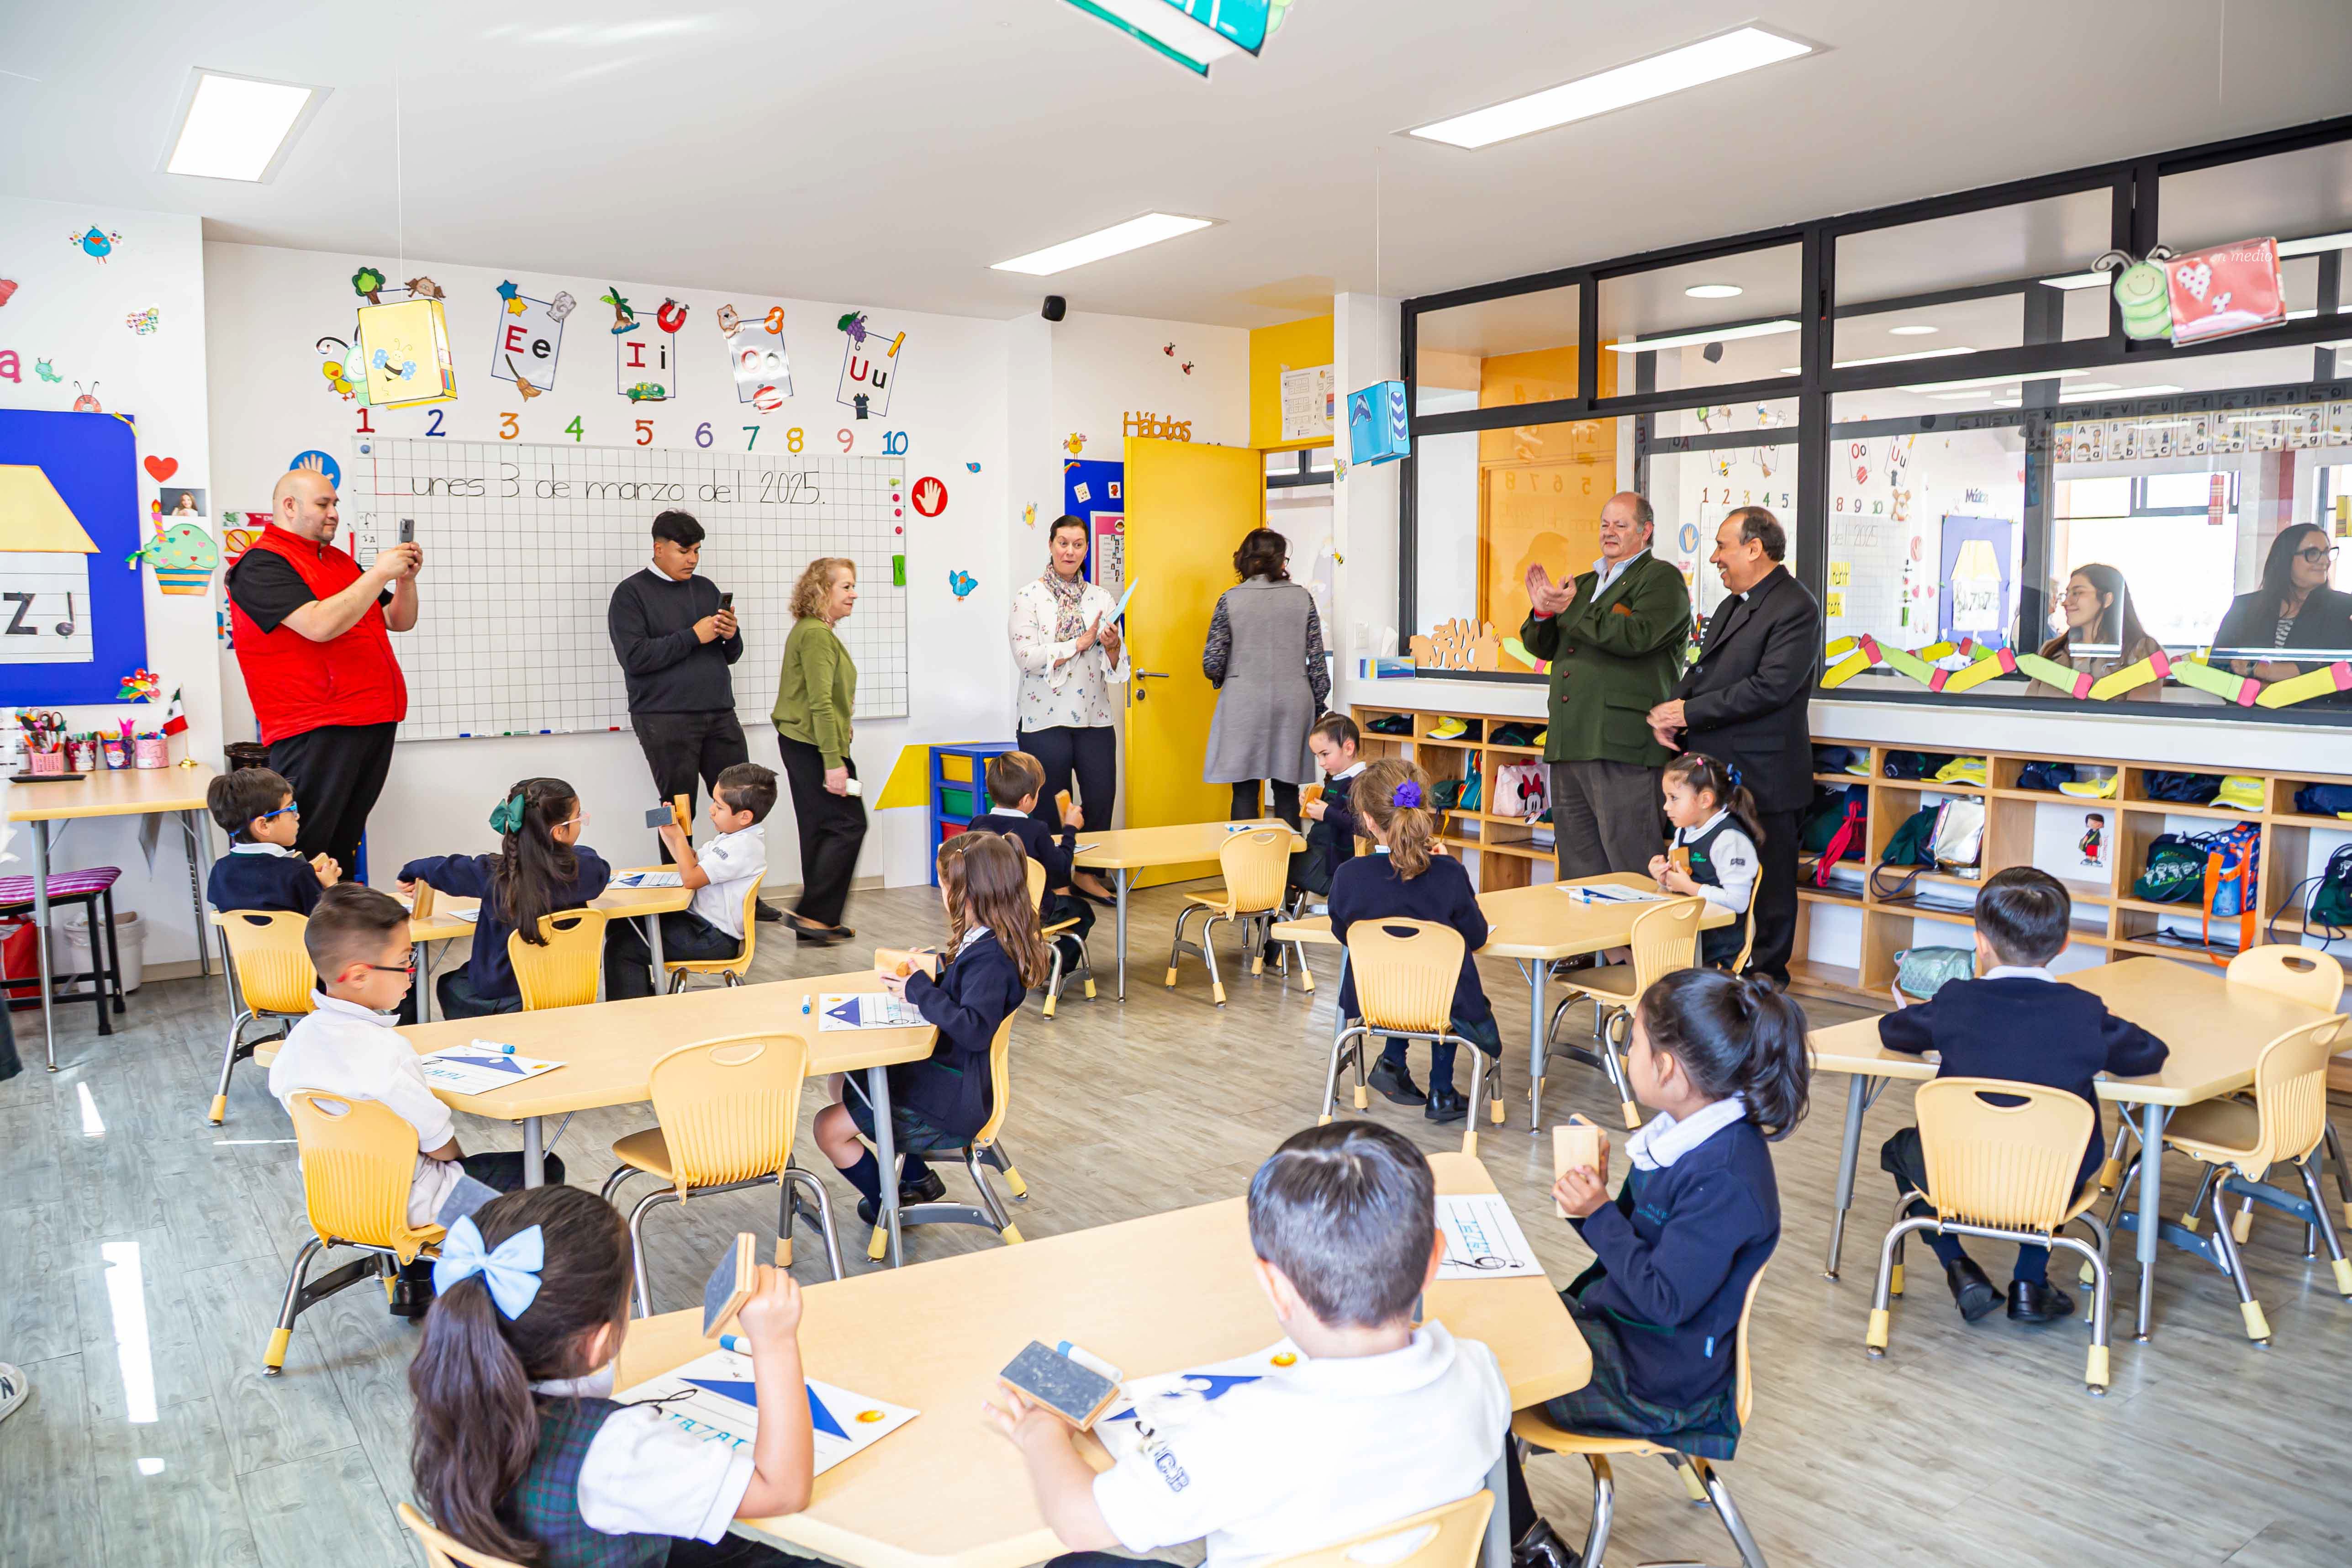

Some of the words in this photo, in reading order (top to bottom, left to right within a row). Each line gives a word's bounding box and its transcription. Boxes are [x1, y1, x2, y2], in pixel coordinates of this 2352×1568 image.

[2231, 249, 2273, 262] medio
[1351, 395, 1372, 427] A
[357, 408, 375, 433] 1
[425, 409, 446, 437] 2
[499, 412, 520, 440] 3
[564, 416, 584, 442] 4
[635, 419, 654, 446] 5
[695, 422, 713, 448] 6
[743, 425, 760, 451] 7
[786, 427, 804, 453] 8
[837, 428, 854, 453] 9
[882, 431, 909, 455] 10
[374, 458, 485, 496] Lunes
[501, 463, 520, 497] 3
[536, 463, 570, 499] de
[586, 481, 684, 501] marzo
[760, 471, 825, 504] 2025.
[1702, 487, 1709, 503] 1
[1722, 489, 1730, 505] 2
[1763, 492, 1770, 507] 4
[1782, 493, 1789, 508] 5
[1836, 497, 1843, 512] 8
[1854, 499, 1862, 512] 9
[1872, 500, 1883, 514] 10
